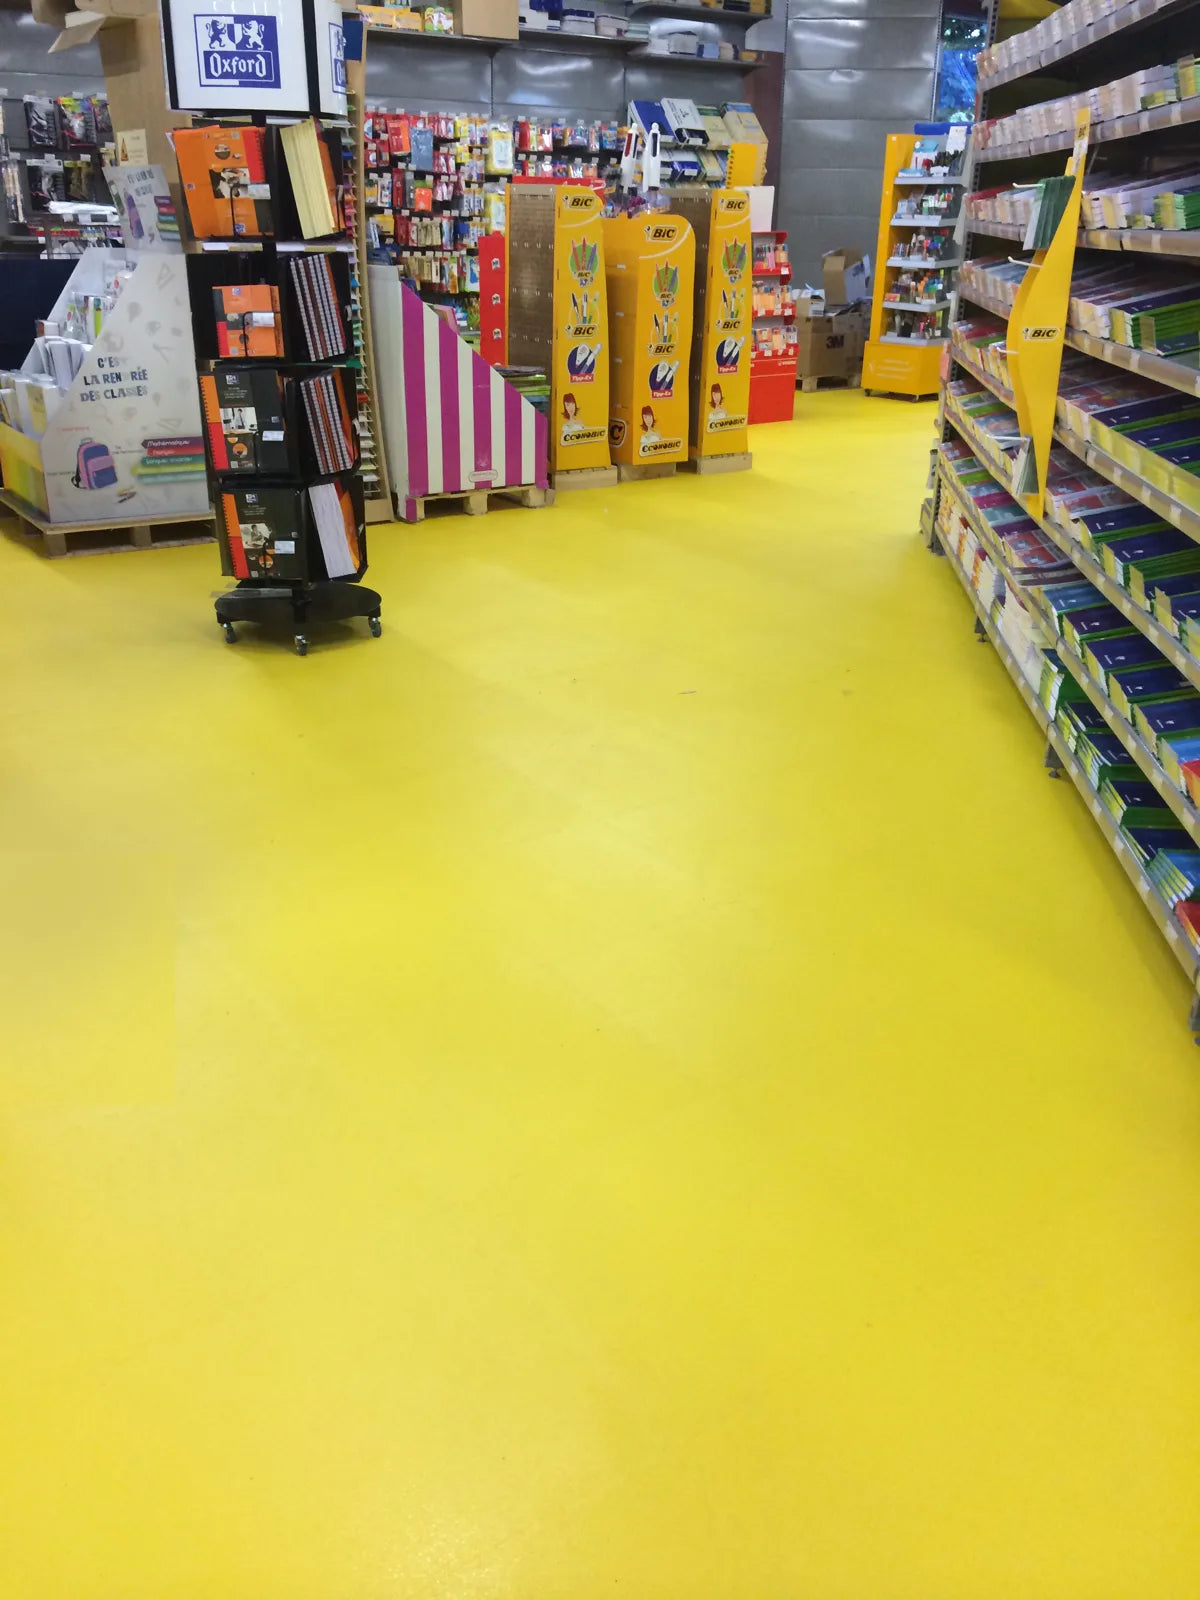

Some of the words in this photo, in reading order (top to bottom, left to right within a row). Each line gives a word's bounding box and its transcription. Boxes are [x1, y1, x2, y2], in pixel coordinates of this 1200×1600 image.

[209, 52, 267, 78] Oxford
[826, 335, 845, 349] 3M
[83, 374, 101, 386] LA
[102, 365, 149, 384] RENRÉE
